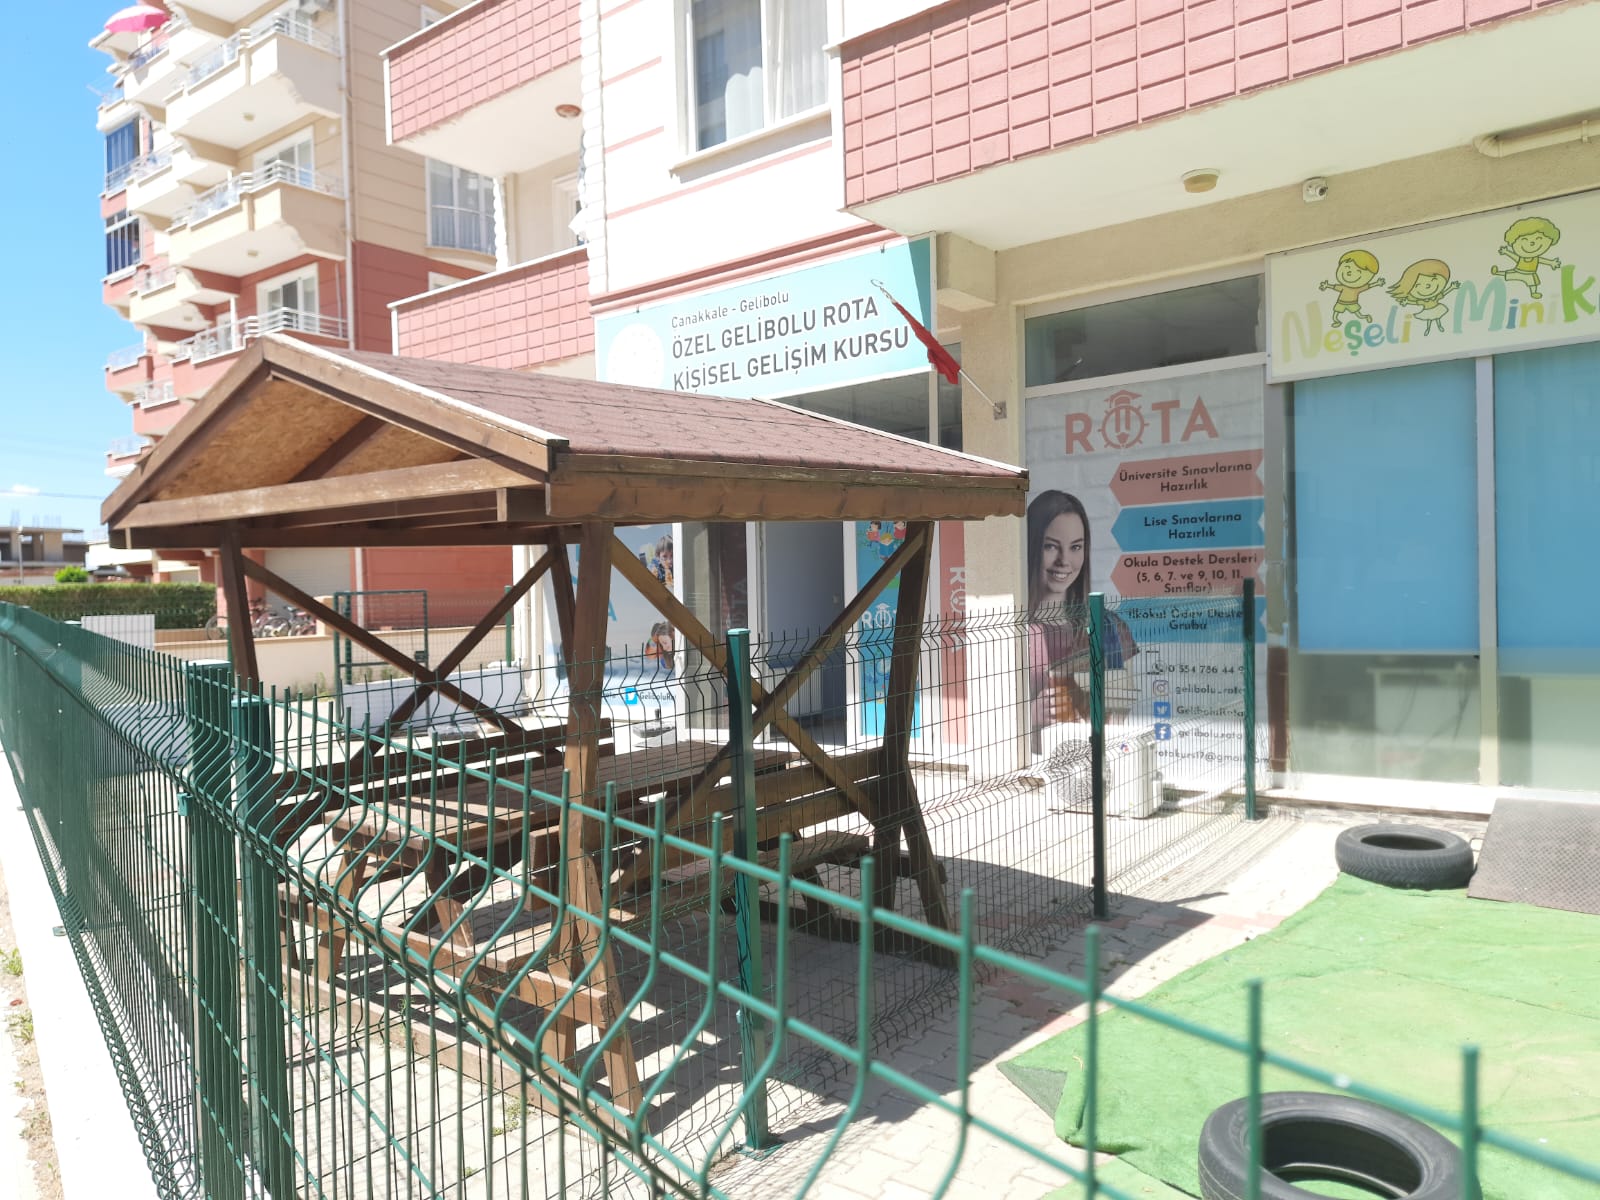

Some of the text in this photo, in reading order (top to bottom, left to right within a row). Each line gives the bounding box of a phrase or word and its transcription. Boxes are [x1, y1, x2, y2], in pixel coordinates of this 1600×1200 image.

[740, 291, 789, 313] Gelibolu
[672, 296, 878, 359] ÖZEL GELİBOLU ROTA
[1280, 300, 1415, 364] Neşeli
[673, 326, 909, 393] KİŞİSEL GELİŞİM KURSU
[1065, 392, 1219, 454] ROTA
[1119, 462, 1253, 482] Üniversite Sınavlarına
[1160, 478, 1208, 492] Hazırlık
[1143, 512, 1242, 527] Lise Sınavlarına
[1168, 526, 1216, 539] Hazırlık
[1123, 552, 1257, 568] Okula Destek Dersleri
[1136, 572, 1150, 583] (5,
[1180, 573, 1194, 581] ve
